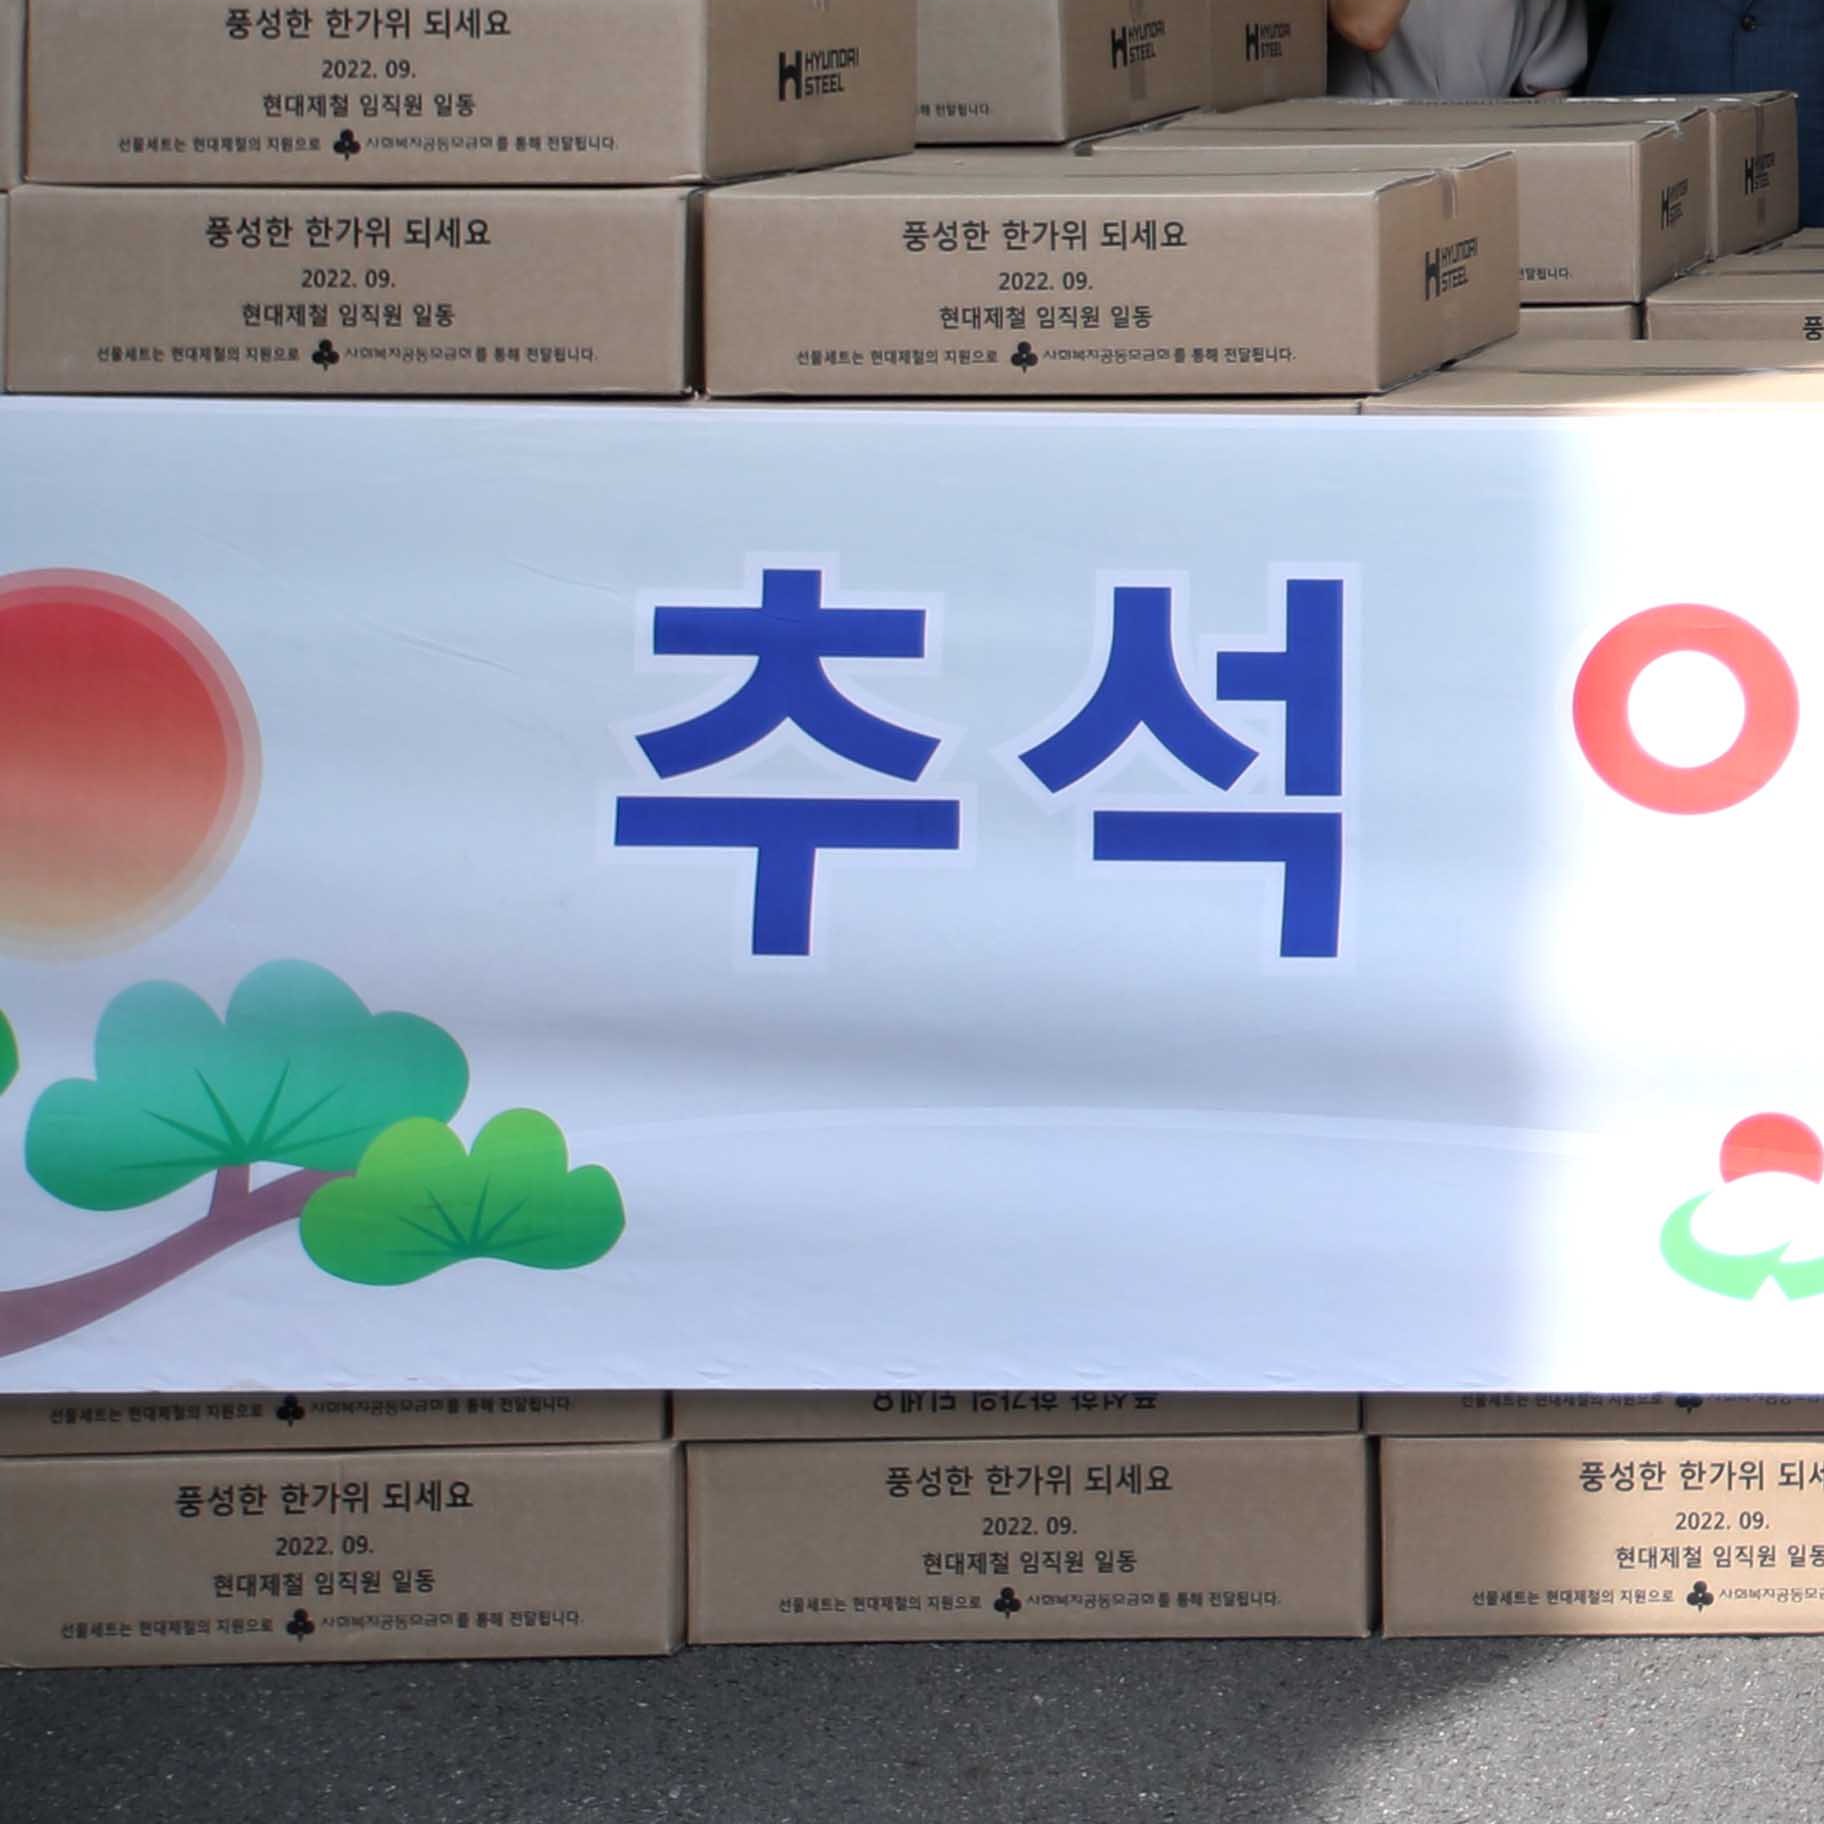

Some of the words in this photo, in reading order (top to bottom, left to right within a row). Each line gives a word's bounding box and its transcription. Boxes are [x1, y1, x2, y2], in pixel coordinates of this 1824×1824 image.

[225, 7, 314, 41] 풍성한
[325, 7, 412, 41] 한가위
[423, 7, 512, 41] 되세요
[321, 58, 379, 81] 2022.
[384, 58, 417, 80] 09.
[804, 47, 860, 73] HYUNDAI
[804, 73, 845, 96] STEEL
[263, 93, 350, 120] 현대제철
[359, 93, 424, 119] 임직원
[433, 92, 477, 119] 일동
[205, 215, 295, 250] 풍성한
[305, 215, 392, 250] 한가위
[403, 216, 492, 250] 되세요
[902, 219, 992, 254] 풍성한
[1001, 219, 1088, 253] 한가위
[1099, 219, 1189, 253] 되세요
[612, 566, 1345, 960] 추석
[1578, 1460, 1668, 1494] 풍성한
[1679, 1459, 1765, 1493] 한가위
[175, 1483, 269, 1520] 풍성한
[280, 1481, 370, 1517] 한가위
[382, 1479, 475, 1514] 되세요
